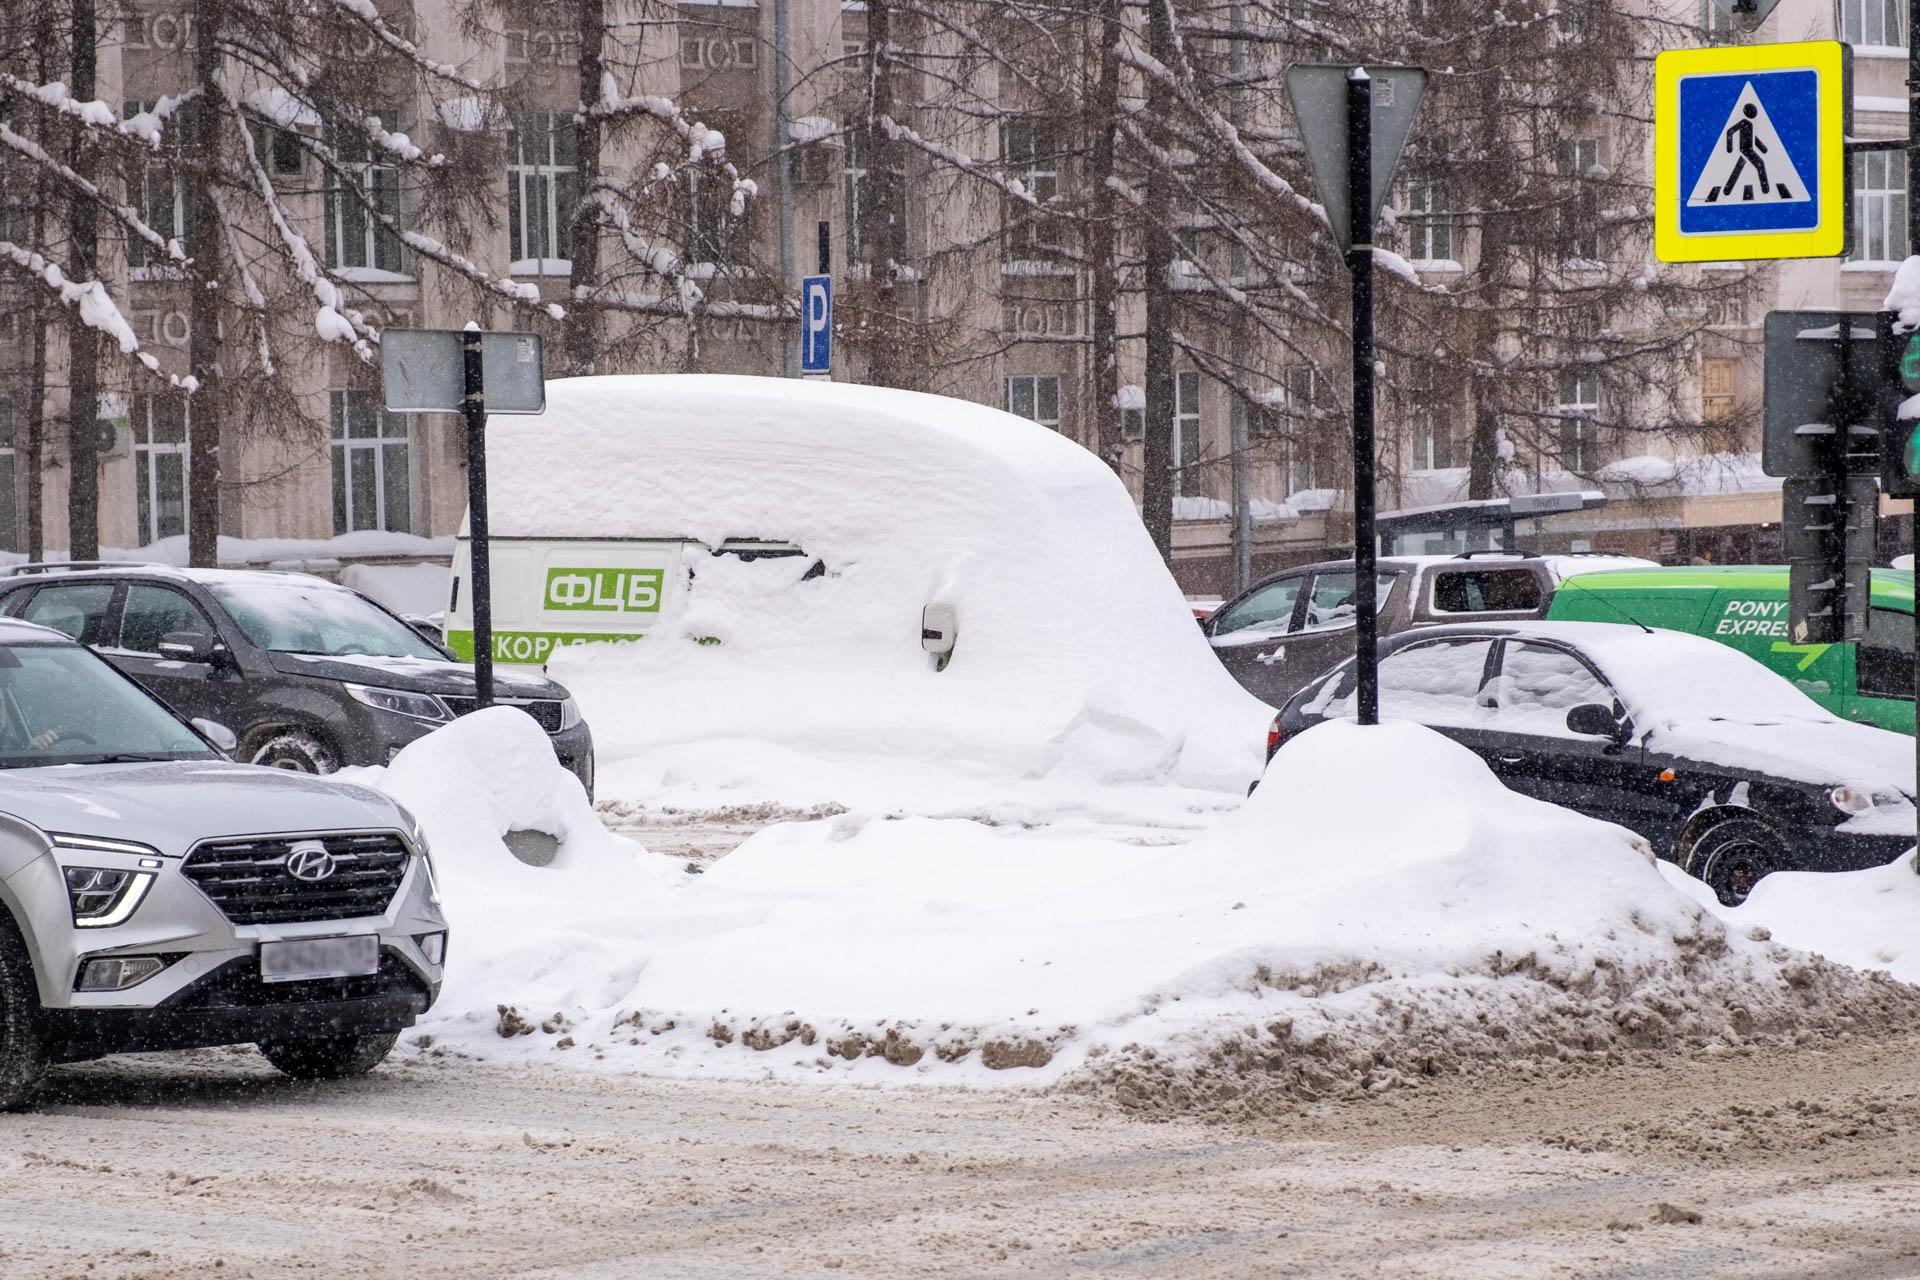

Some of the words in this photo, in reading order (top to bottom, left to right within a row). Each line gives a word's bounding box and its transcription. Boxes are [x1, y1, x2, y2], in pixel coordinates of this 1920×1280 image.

[809, 284, 828, 363] P
[549, 573, 658, 611] ФЦБ
[1724, 600, 1788, 617] PONY
